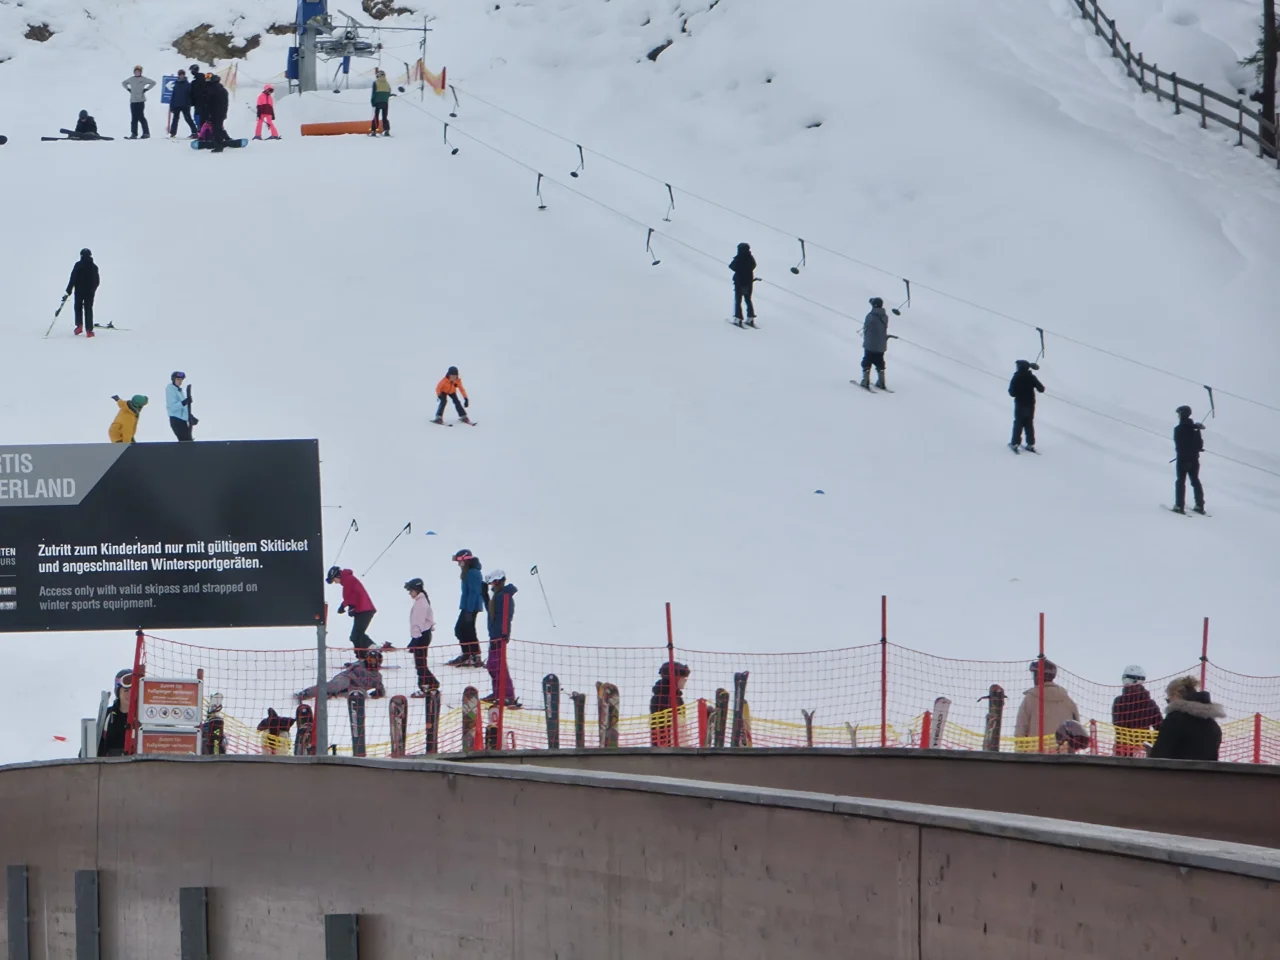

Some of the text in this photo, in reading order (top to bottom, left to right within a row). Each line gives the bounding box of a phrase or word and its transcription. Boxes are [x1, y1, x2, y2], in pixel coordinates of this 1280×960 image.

[38, 539, 308, 556] Zutritt zum Kinderland nur mit gültigem Skiticket
[38, 556, 263, 574] und angeschnallten Wintersportgeräten.
[39, 582, 258, 597] Access only with valid skipass and strapped on
[39, 598, 156, 611] winter sports equipment.
